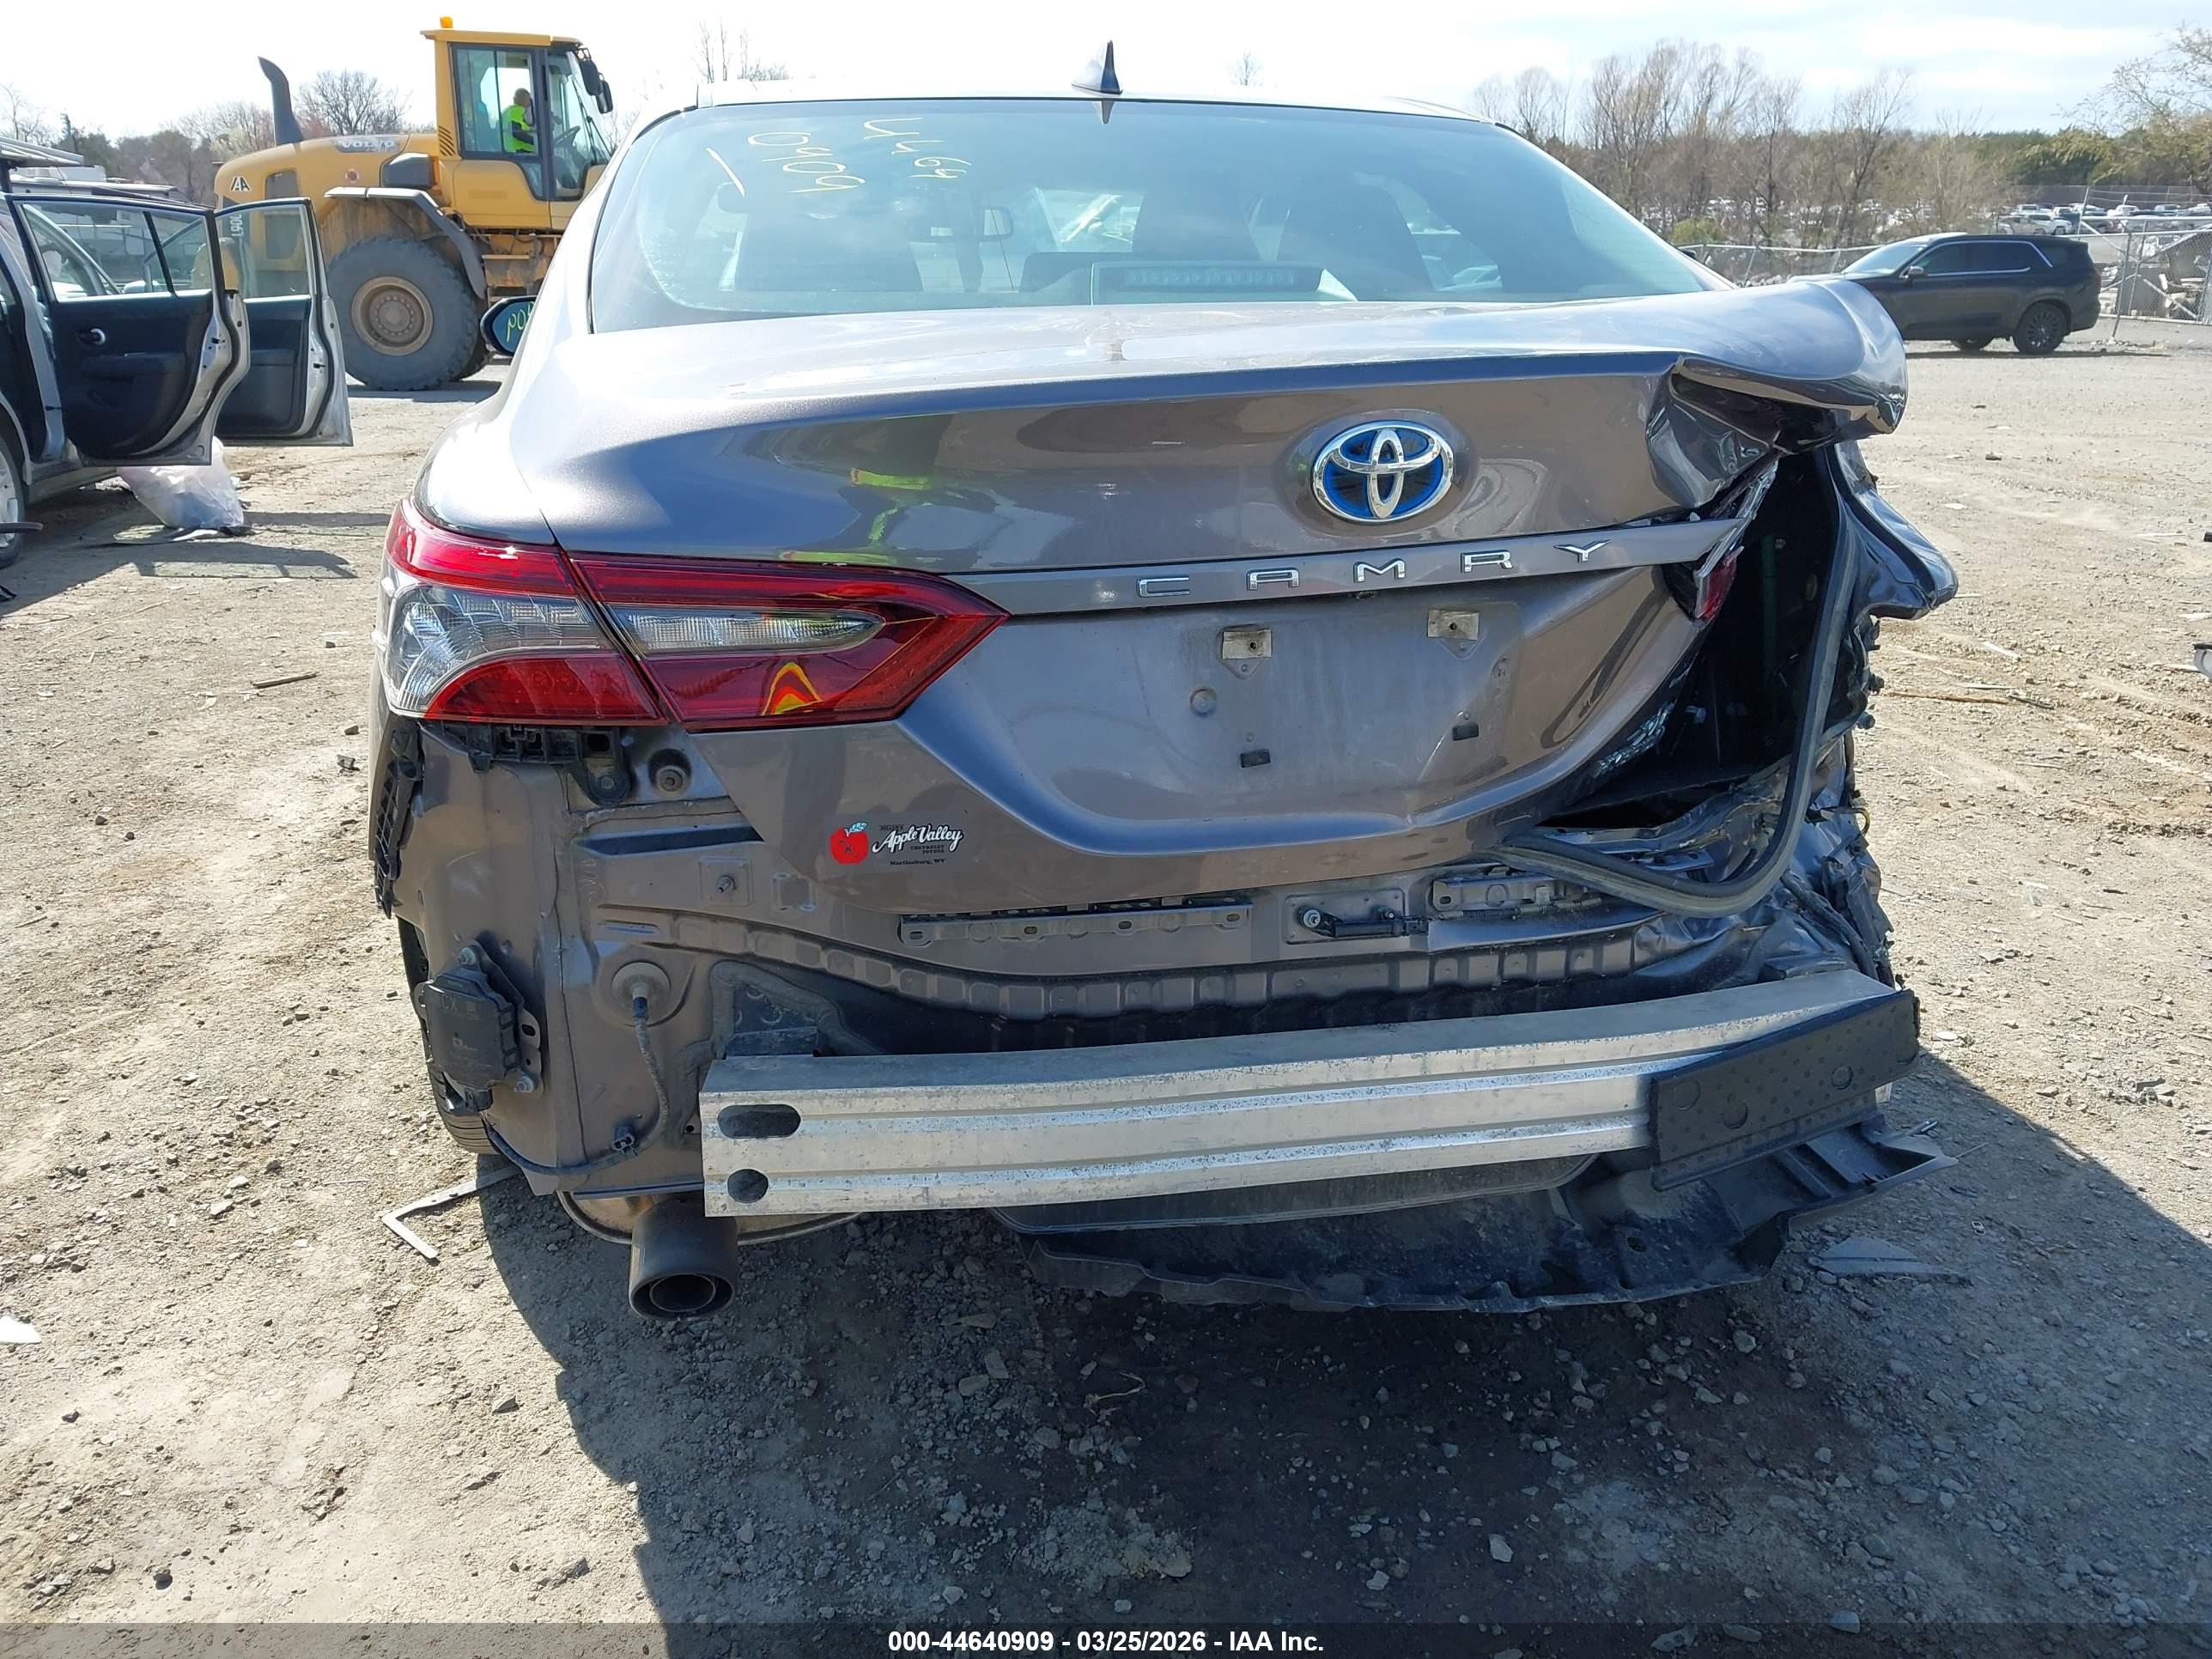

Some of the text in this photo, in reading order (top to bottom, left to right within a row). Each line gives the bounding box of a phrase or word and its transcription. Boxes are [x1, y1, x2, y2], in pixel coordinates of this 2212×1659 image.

[1136, 538, 1612, 599] CAMRY
[872, 823, 963, 853] Apple Valley
